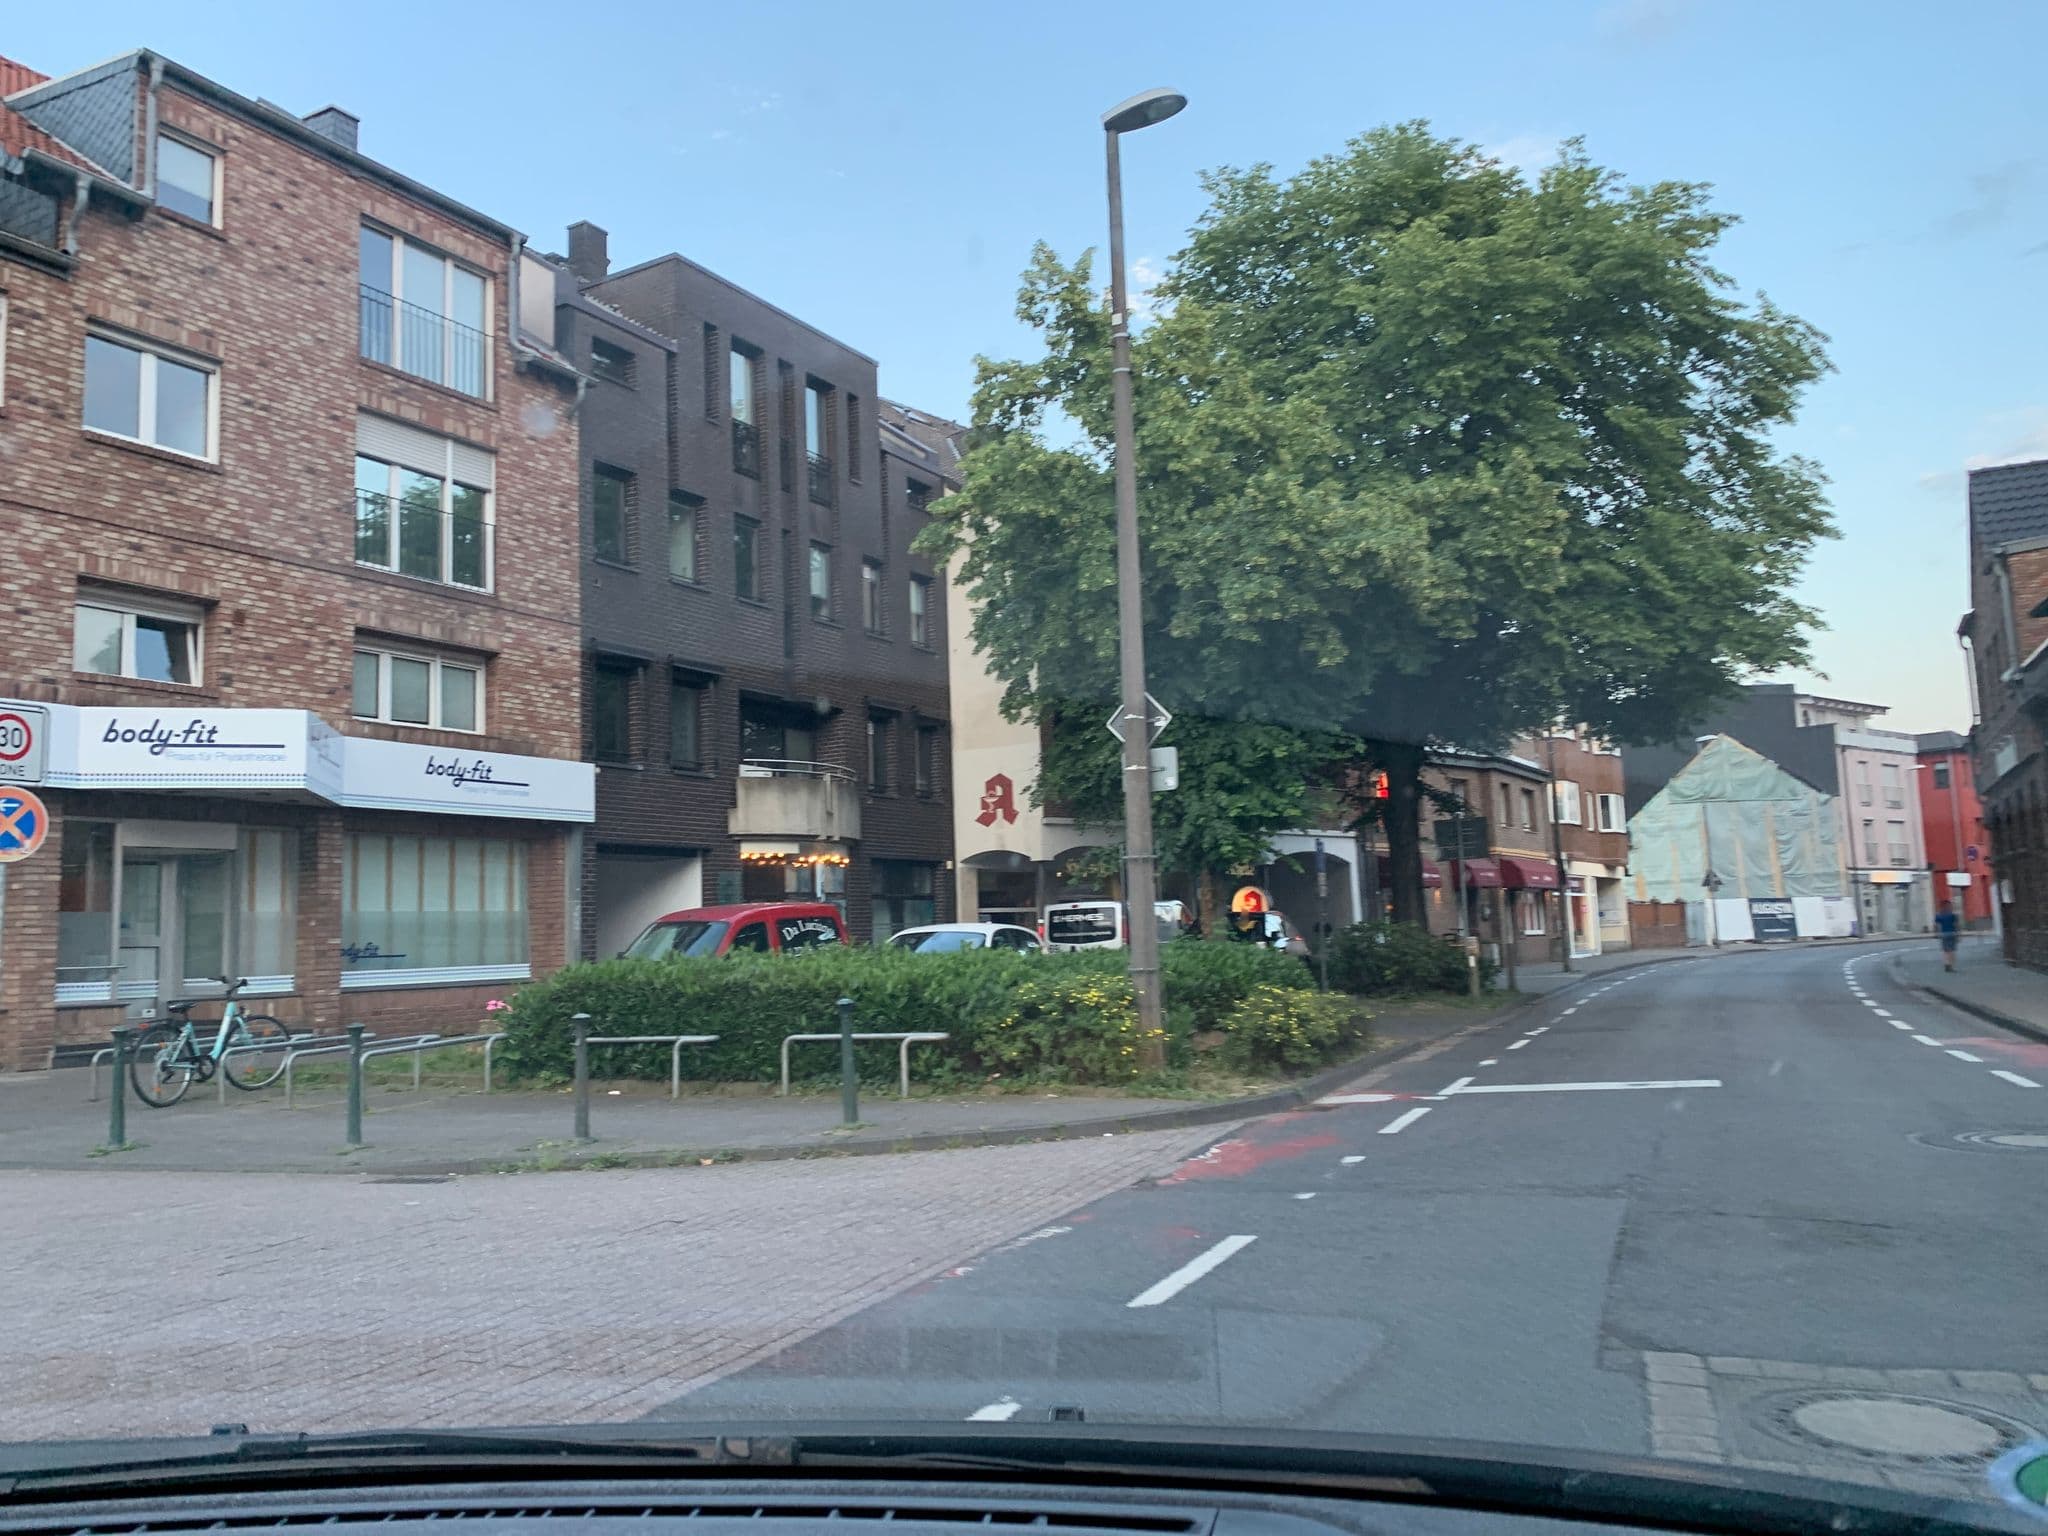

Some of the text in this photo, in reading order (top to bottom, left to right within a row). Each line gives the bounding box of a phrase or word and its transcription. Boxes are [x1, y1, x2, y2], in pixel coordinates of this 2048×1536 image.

[0, 726, 23, 748] 30
[102, 718, 218, 756] body-fit
[0, 763, 25, 777] ONE
[424, 755, 494, 788] body-fit
